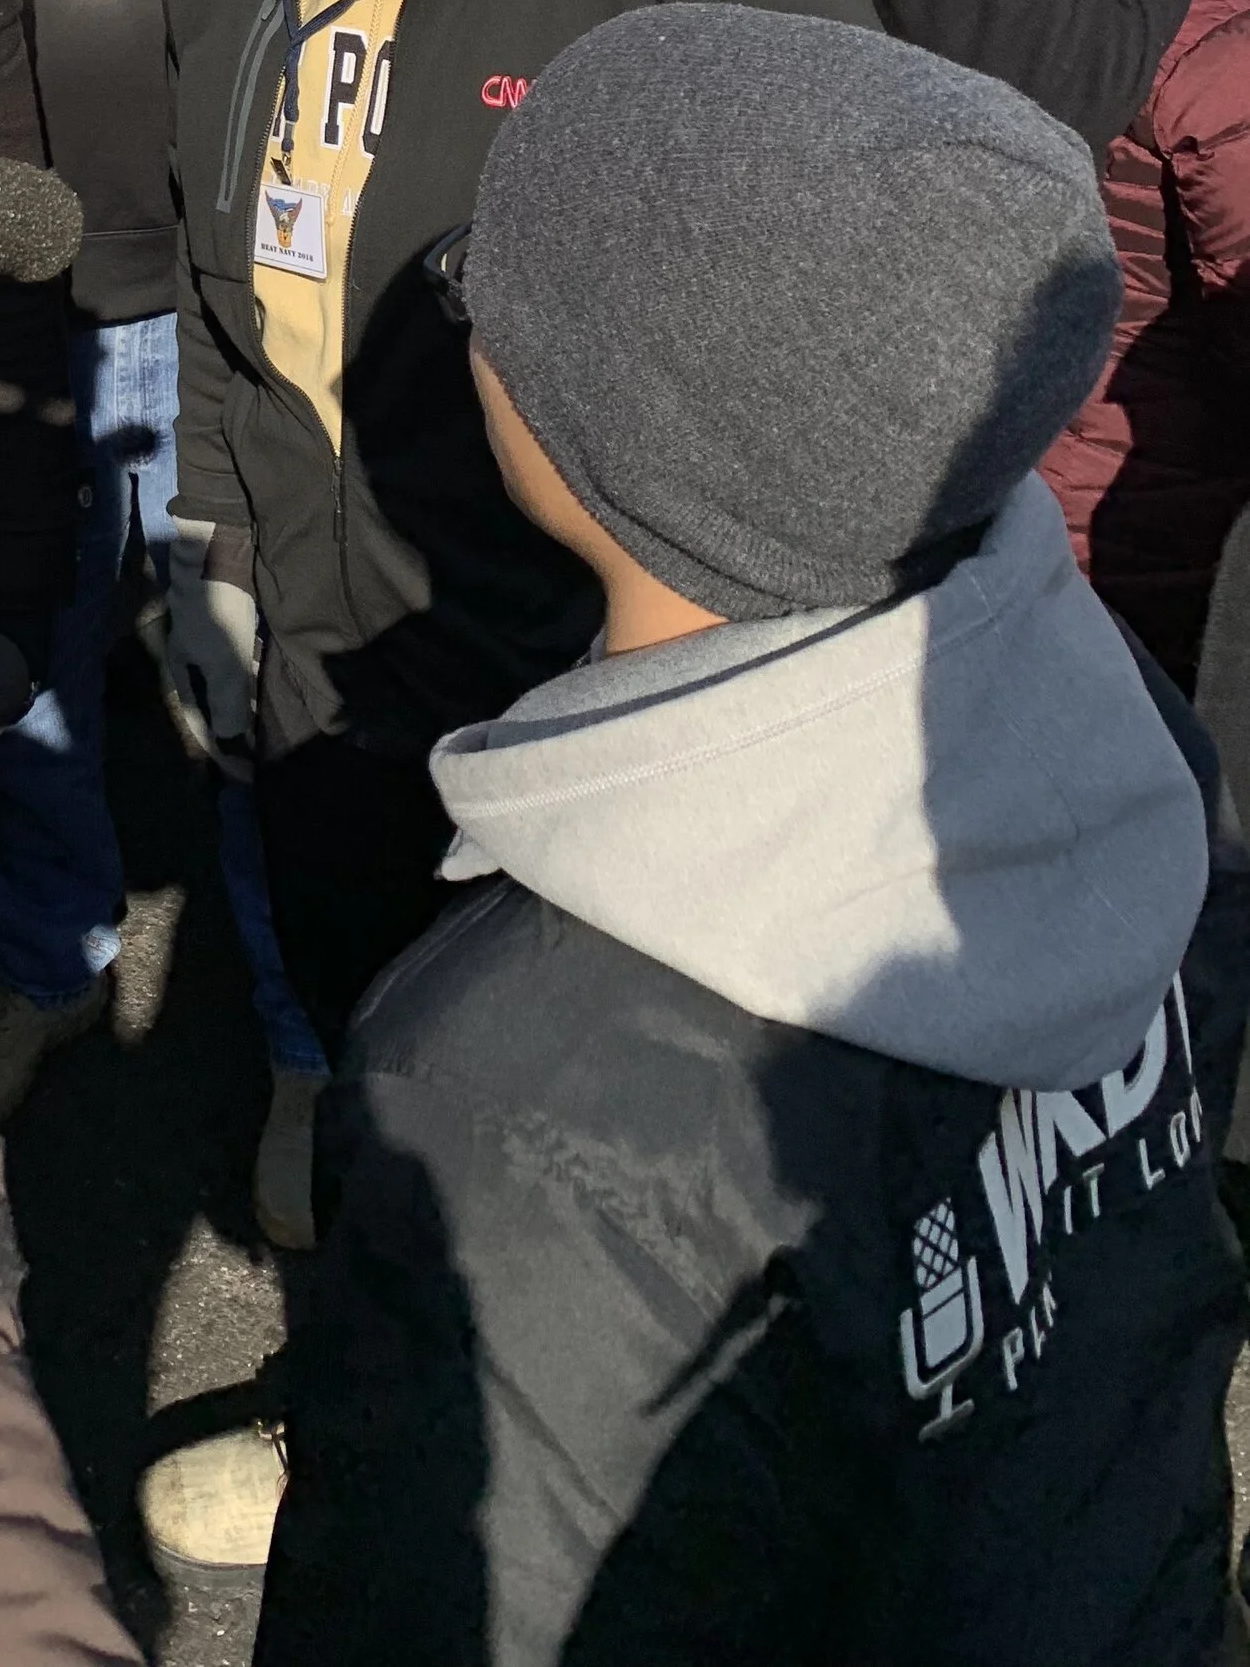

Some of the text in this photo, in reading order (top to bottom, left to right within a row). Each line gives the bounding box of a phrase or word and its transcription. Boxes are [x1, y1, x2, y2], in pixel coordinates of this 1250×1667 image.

[260, 242, 314, 262] BEAT NAVY 2018
